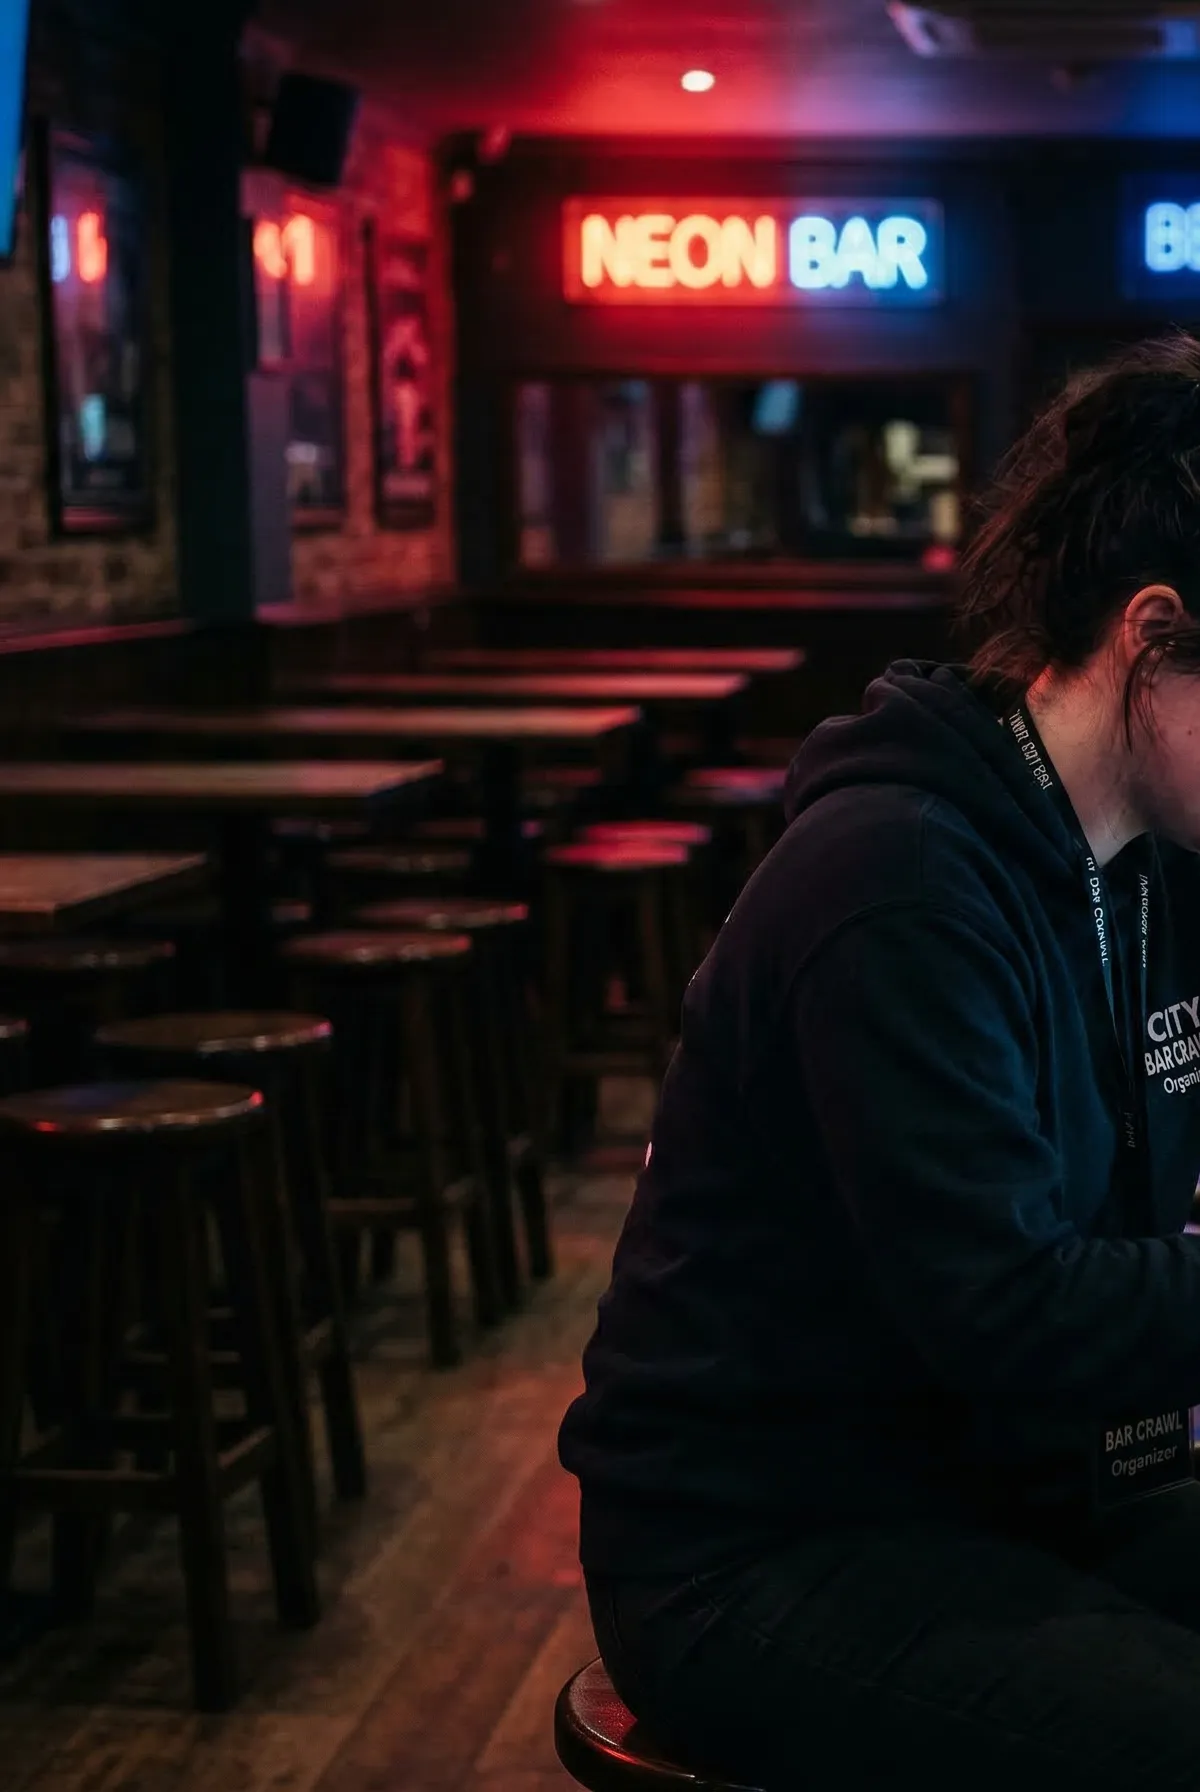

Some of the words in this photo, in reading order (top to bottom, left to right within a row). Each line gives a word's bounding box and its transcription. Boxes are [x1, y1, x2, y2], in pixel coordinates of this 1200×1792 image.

[581, 213, 776, 289] NEON
[789, 216, 928, 289] BAR
[1147, 996, 1200, 1042] CITY
[1144, 1046, 1175, 1076] BAR
[1105, 1424, 1134, 1452] BAR
[1136, 1410, 1183, 1441] CRAWL
[1111, 1445, 1178, 1477] Organizer
